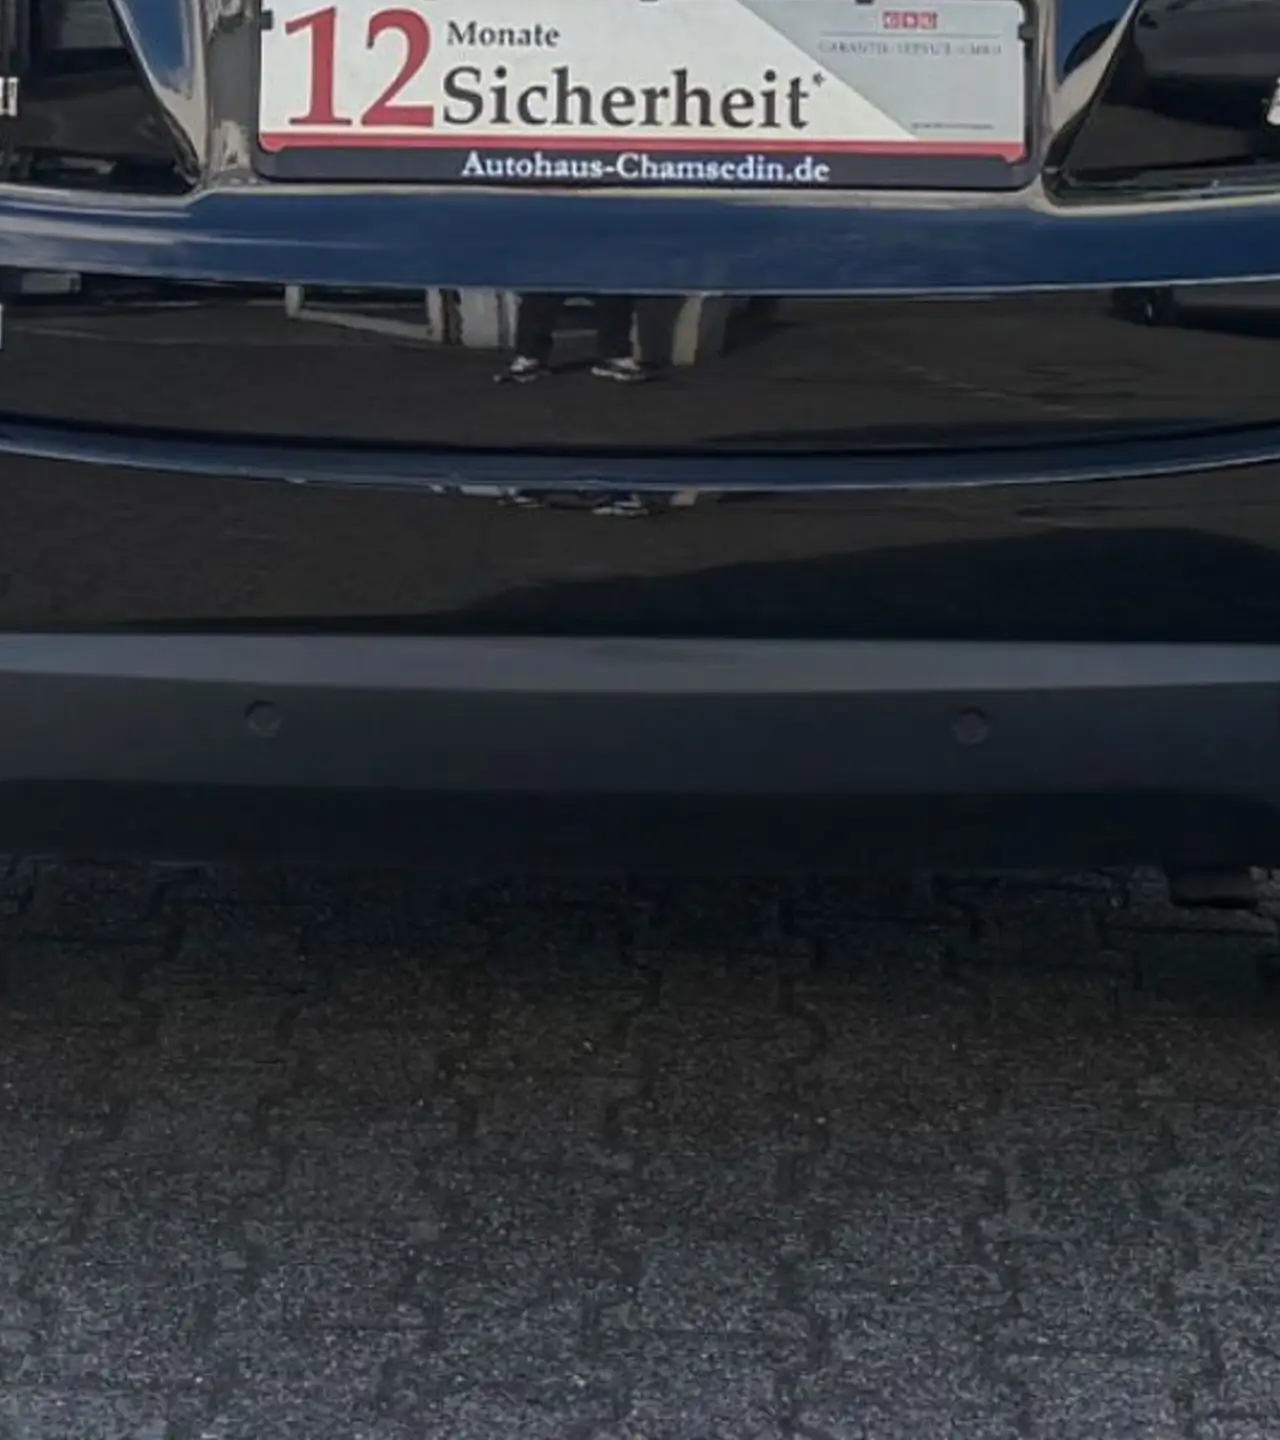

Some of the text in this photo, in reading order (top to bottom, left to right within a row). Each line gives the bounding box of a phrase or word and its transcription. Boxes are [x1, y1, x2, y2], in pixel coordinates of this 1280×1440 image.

[446, 20, 561, 48] Monate
[284, 6, 434, 128] 12
[460, 149, 831, 183] Autohaus-Chamsedin.de
